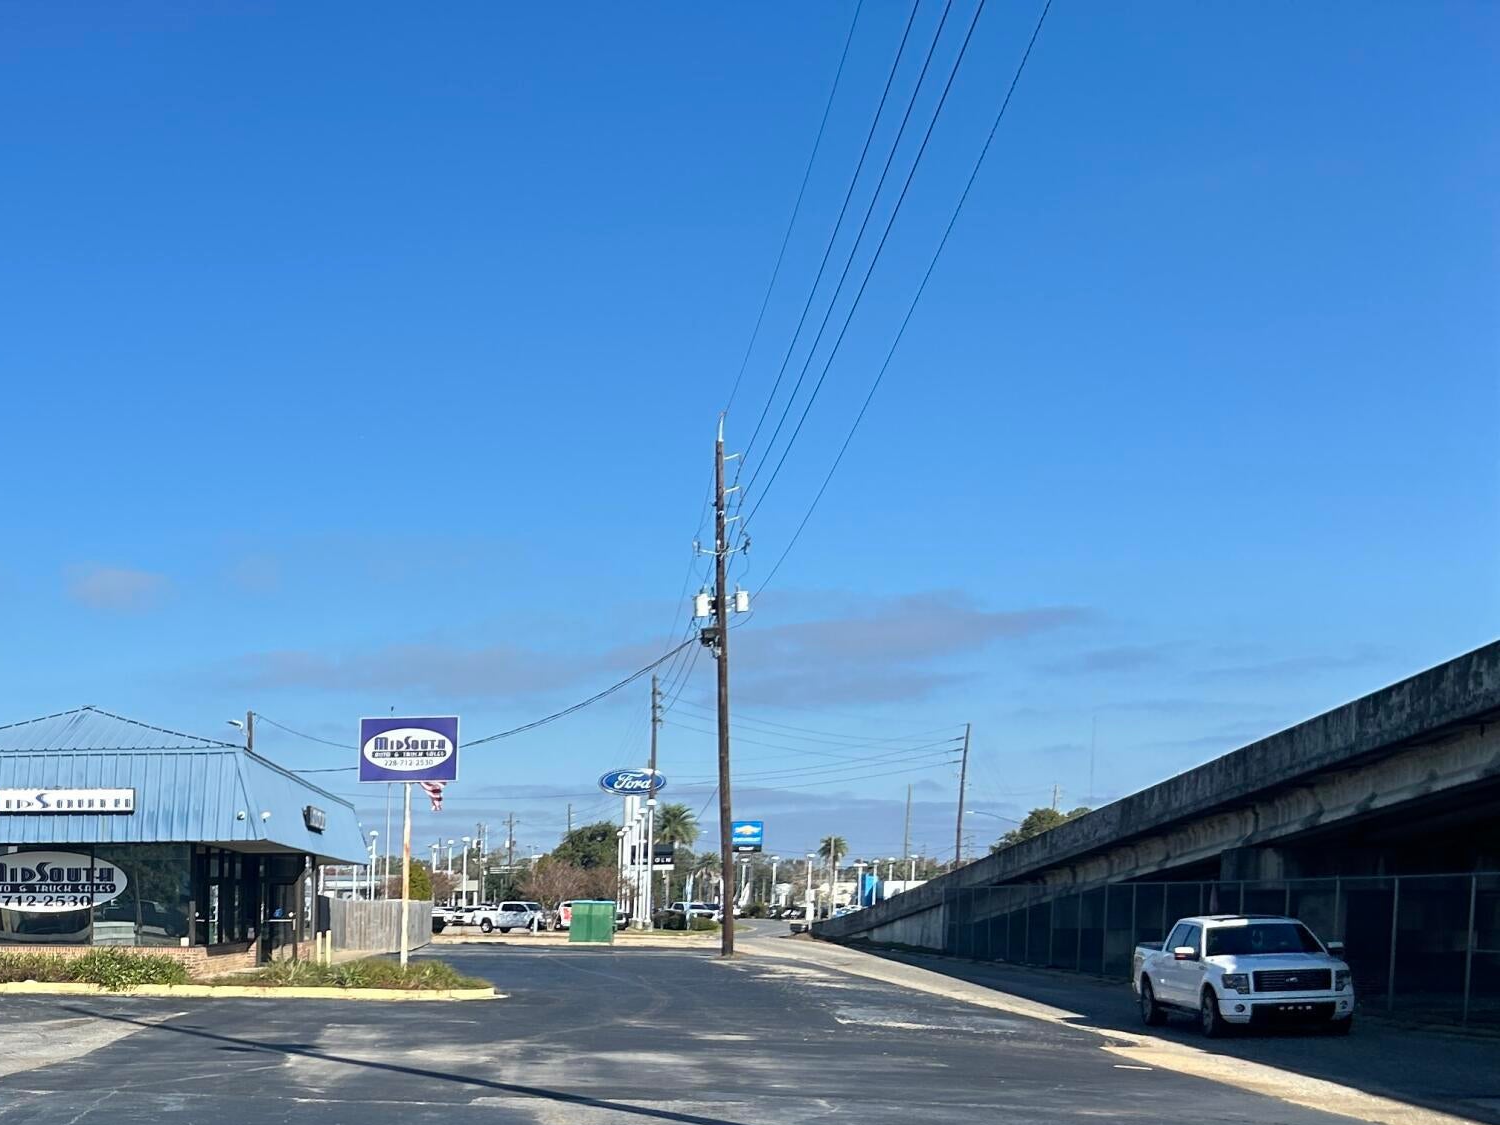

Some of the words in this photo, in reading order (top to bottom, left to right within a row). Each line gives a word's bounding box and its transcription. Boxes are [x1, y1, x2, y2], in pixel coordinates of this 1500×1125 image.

[613, 772, 652, 789] Ford
[36, 884, 72, 892] TRUCK
[78, 884, 111, 892] SALES
[2, 895, 91, 907] 712-2530
